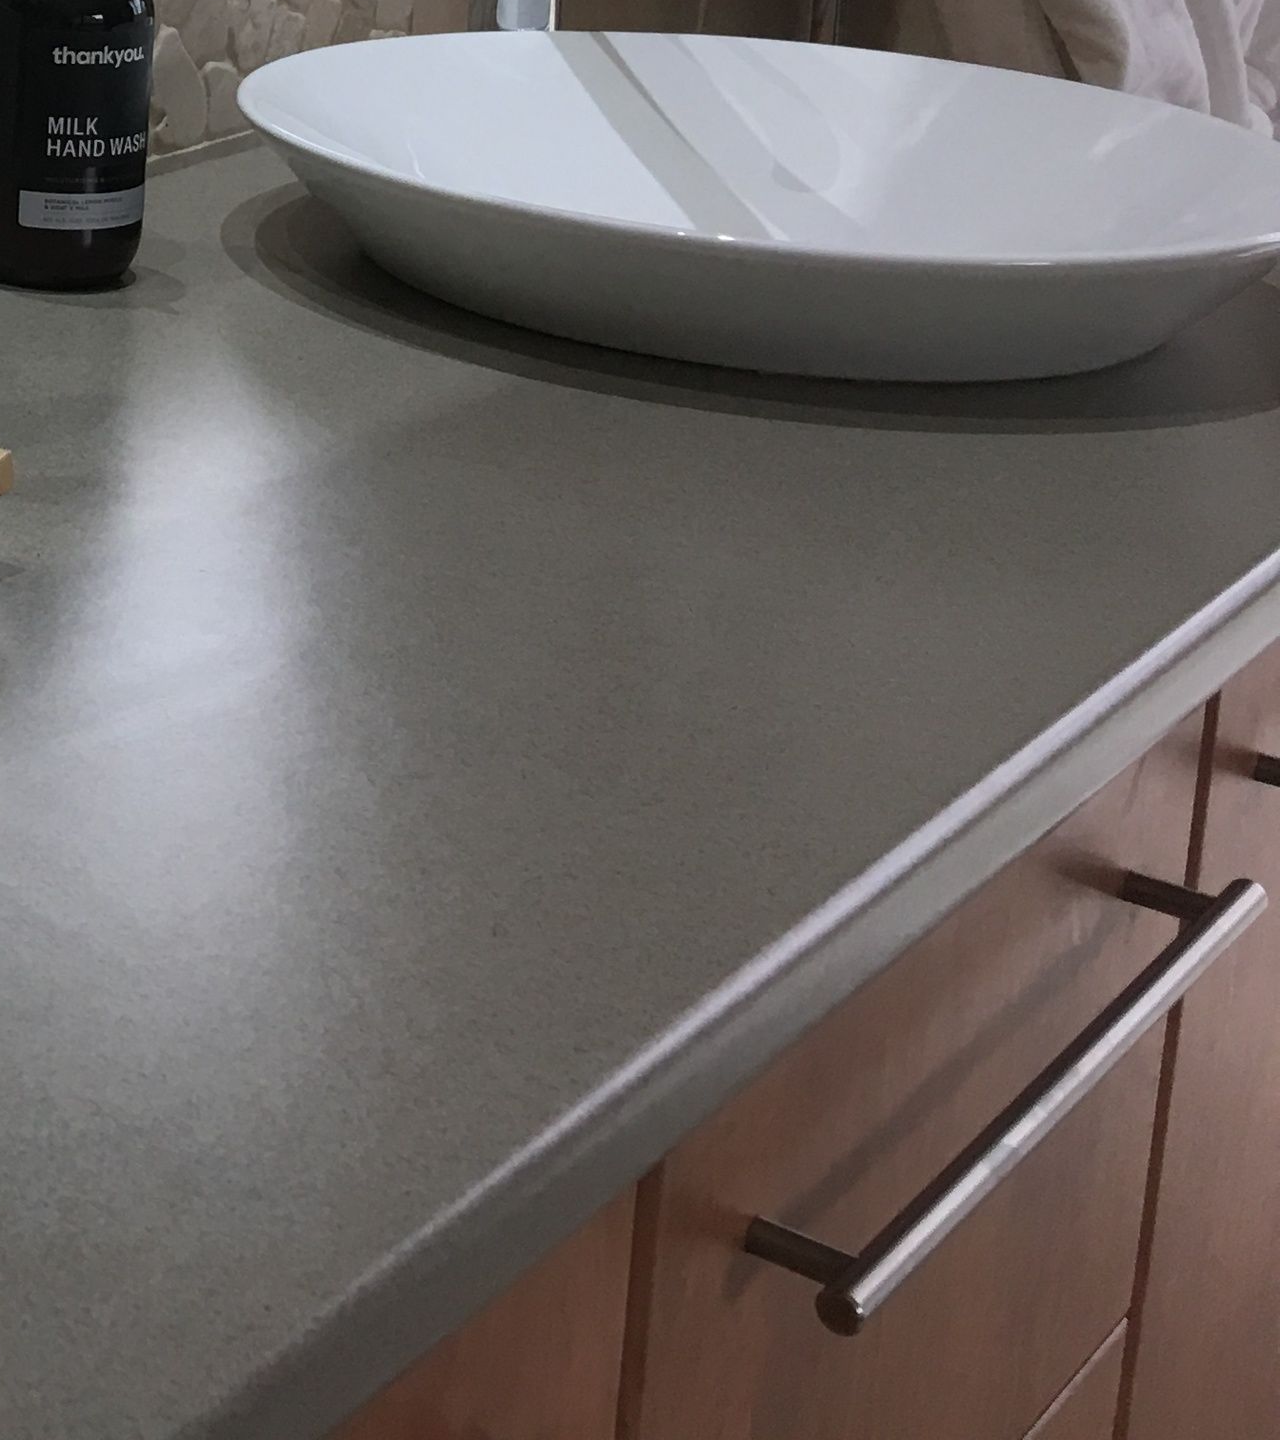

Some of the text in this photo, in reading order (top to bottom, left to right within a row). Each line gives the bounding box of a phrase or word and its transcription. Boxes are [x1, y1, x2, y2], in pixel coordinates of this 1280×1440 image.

[47, 117, 98, 136] MILK
[46, 131, 146, 158] HAND WASH
